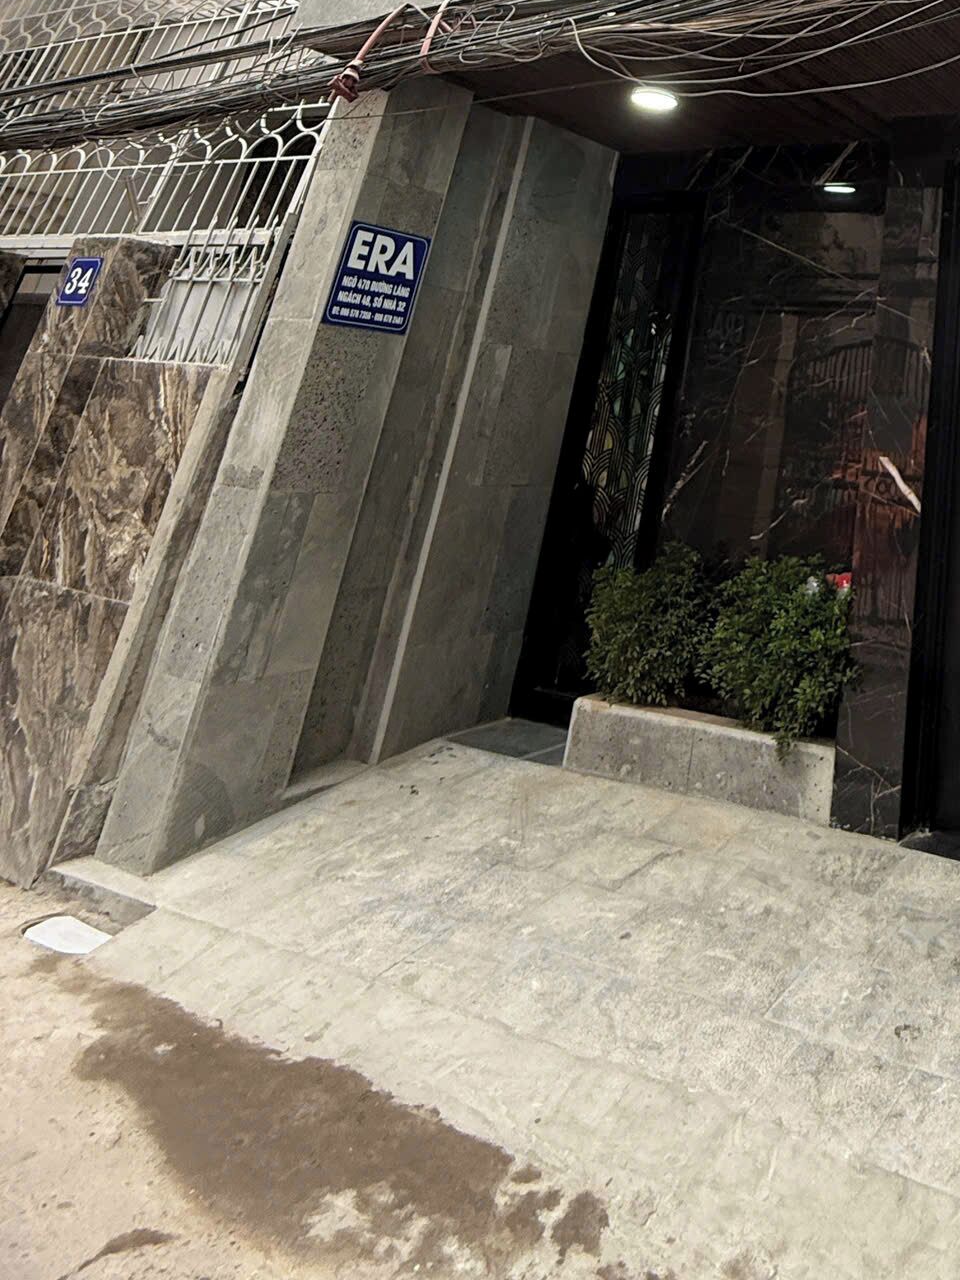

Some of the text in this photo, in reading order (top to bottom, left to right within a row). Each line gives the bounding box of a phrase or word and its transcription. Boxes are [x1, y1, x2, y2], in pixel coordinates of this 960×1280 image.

[347, 230, 414, 280] ERA
[64, 267, 93, 295] 34
[337, 290, 361, 305] NGÁCH
[372, 294, 385, 308] SỐ
